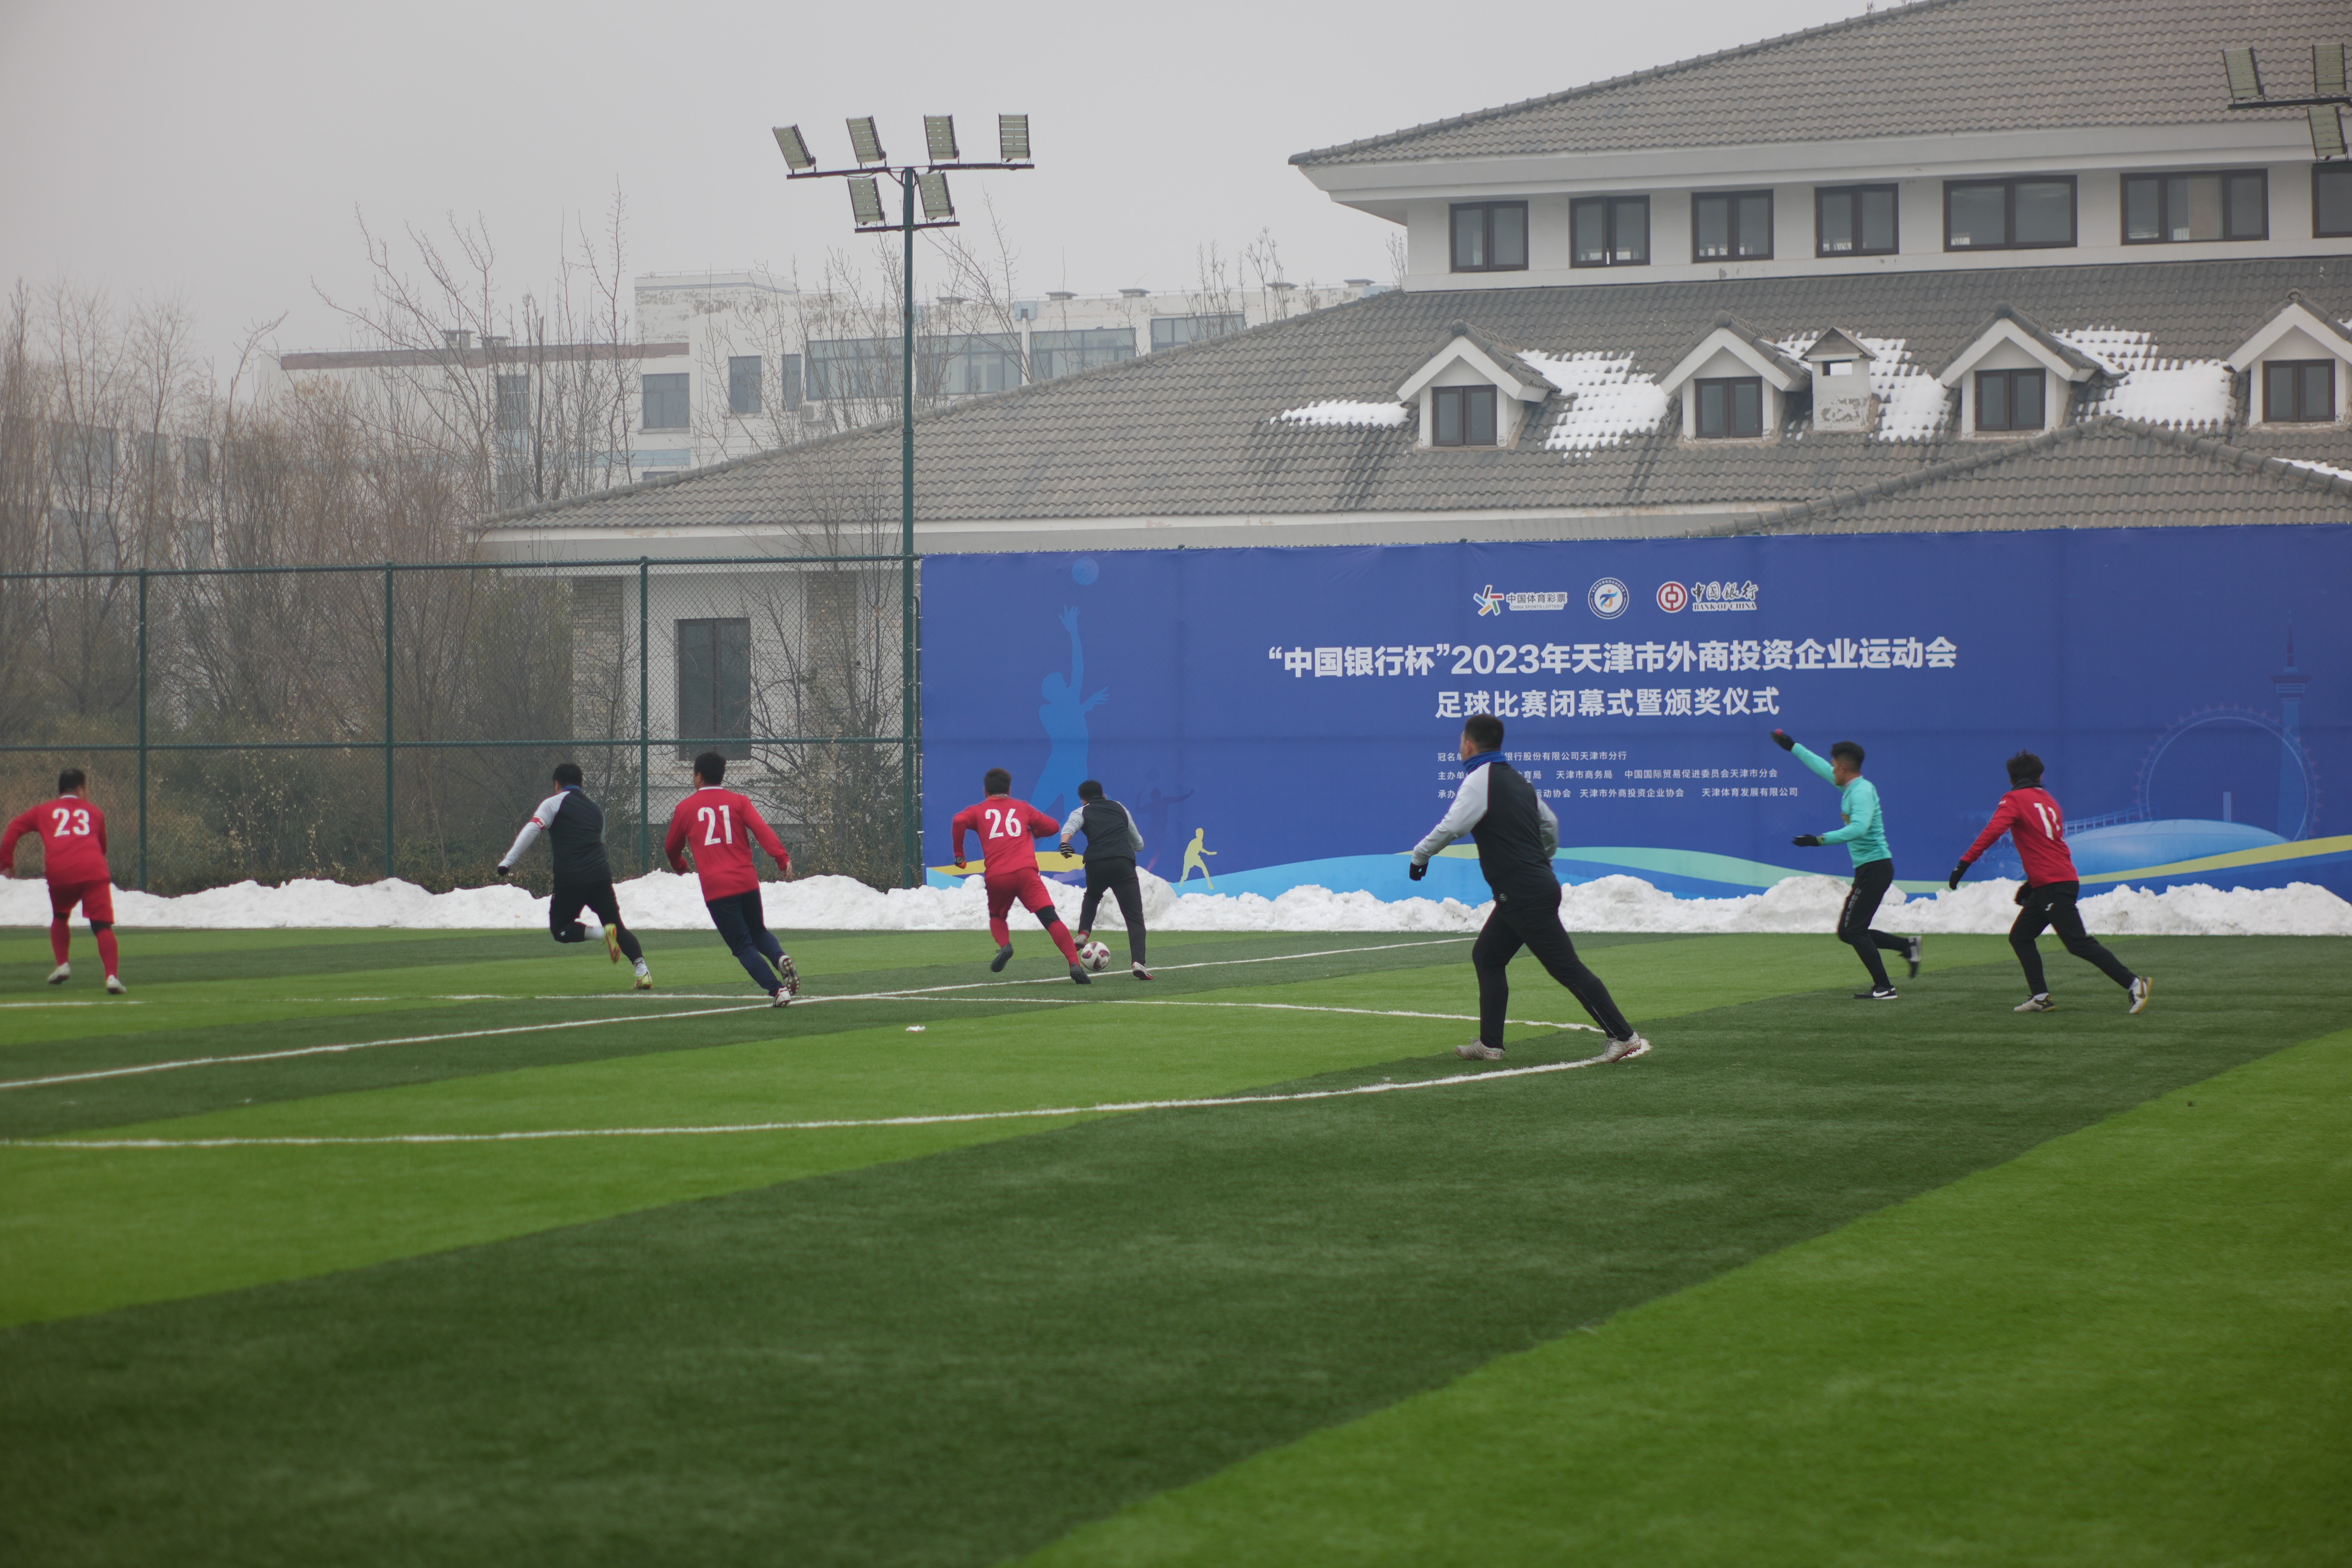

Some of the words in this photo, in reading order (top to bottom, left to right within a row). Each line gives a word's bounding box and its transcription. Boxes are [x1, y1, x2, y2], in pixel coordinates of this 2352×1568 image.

[1508, 594, 1566, 603] 中国体育彩票
[1435, 686, 1780, 718] 足球比赛闭幕式暨颁奖仪式
[1438, 771, 1468, 780] 主办单
[1556, 770, 1612, 779] 天津市商务局
[1625, 768, 1777, 779] 中国国际贸易促进委员会天津市分会
[1580, 788, 1684, 798] 天津市外商投资企业协会
[1702, 787, 1797, 797] 天津体育发展有限公司
[52, 808, 90, 837] 23
[698, 805, 732, 846] 21
[985, 808, 1021, 839] 26
